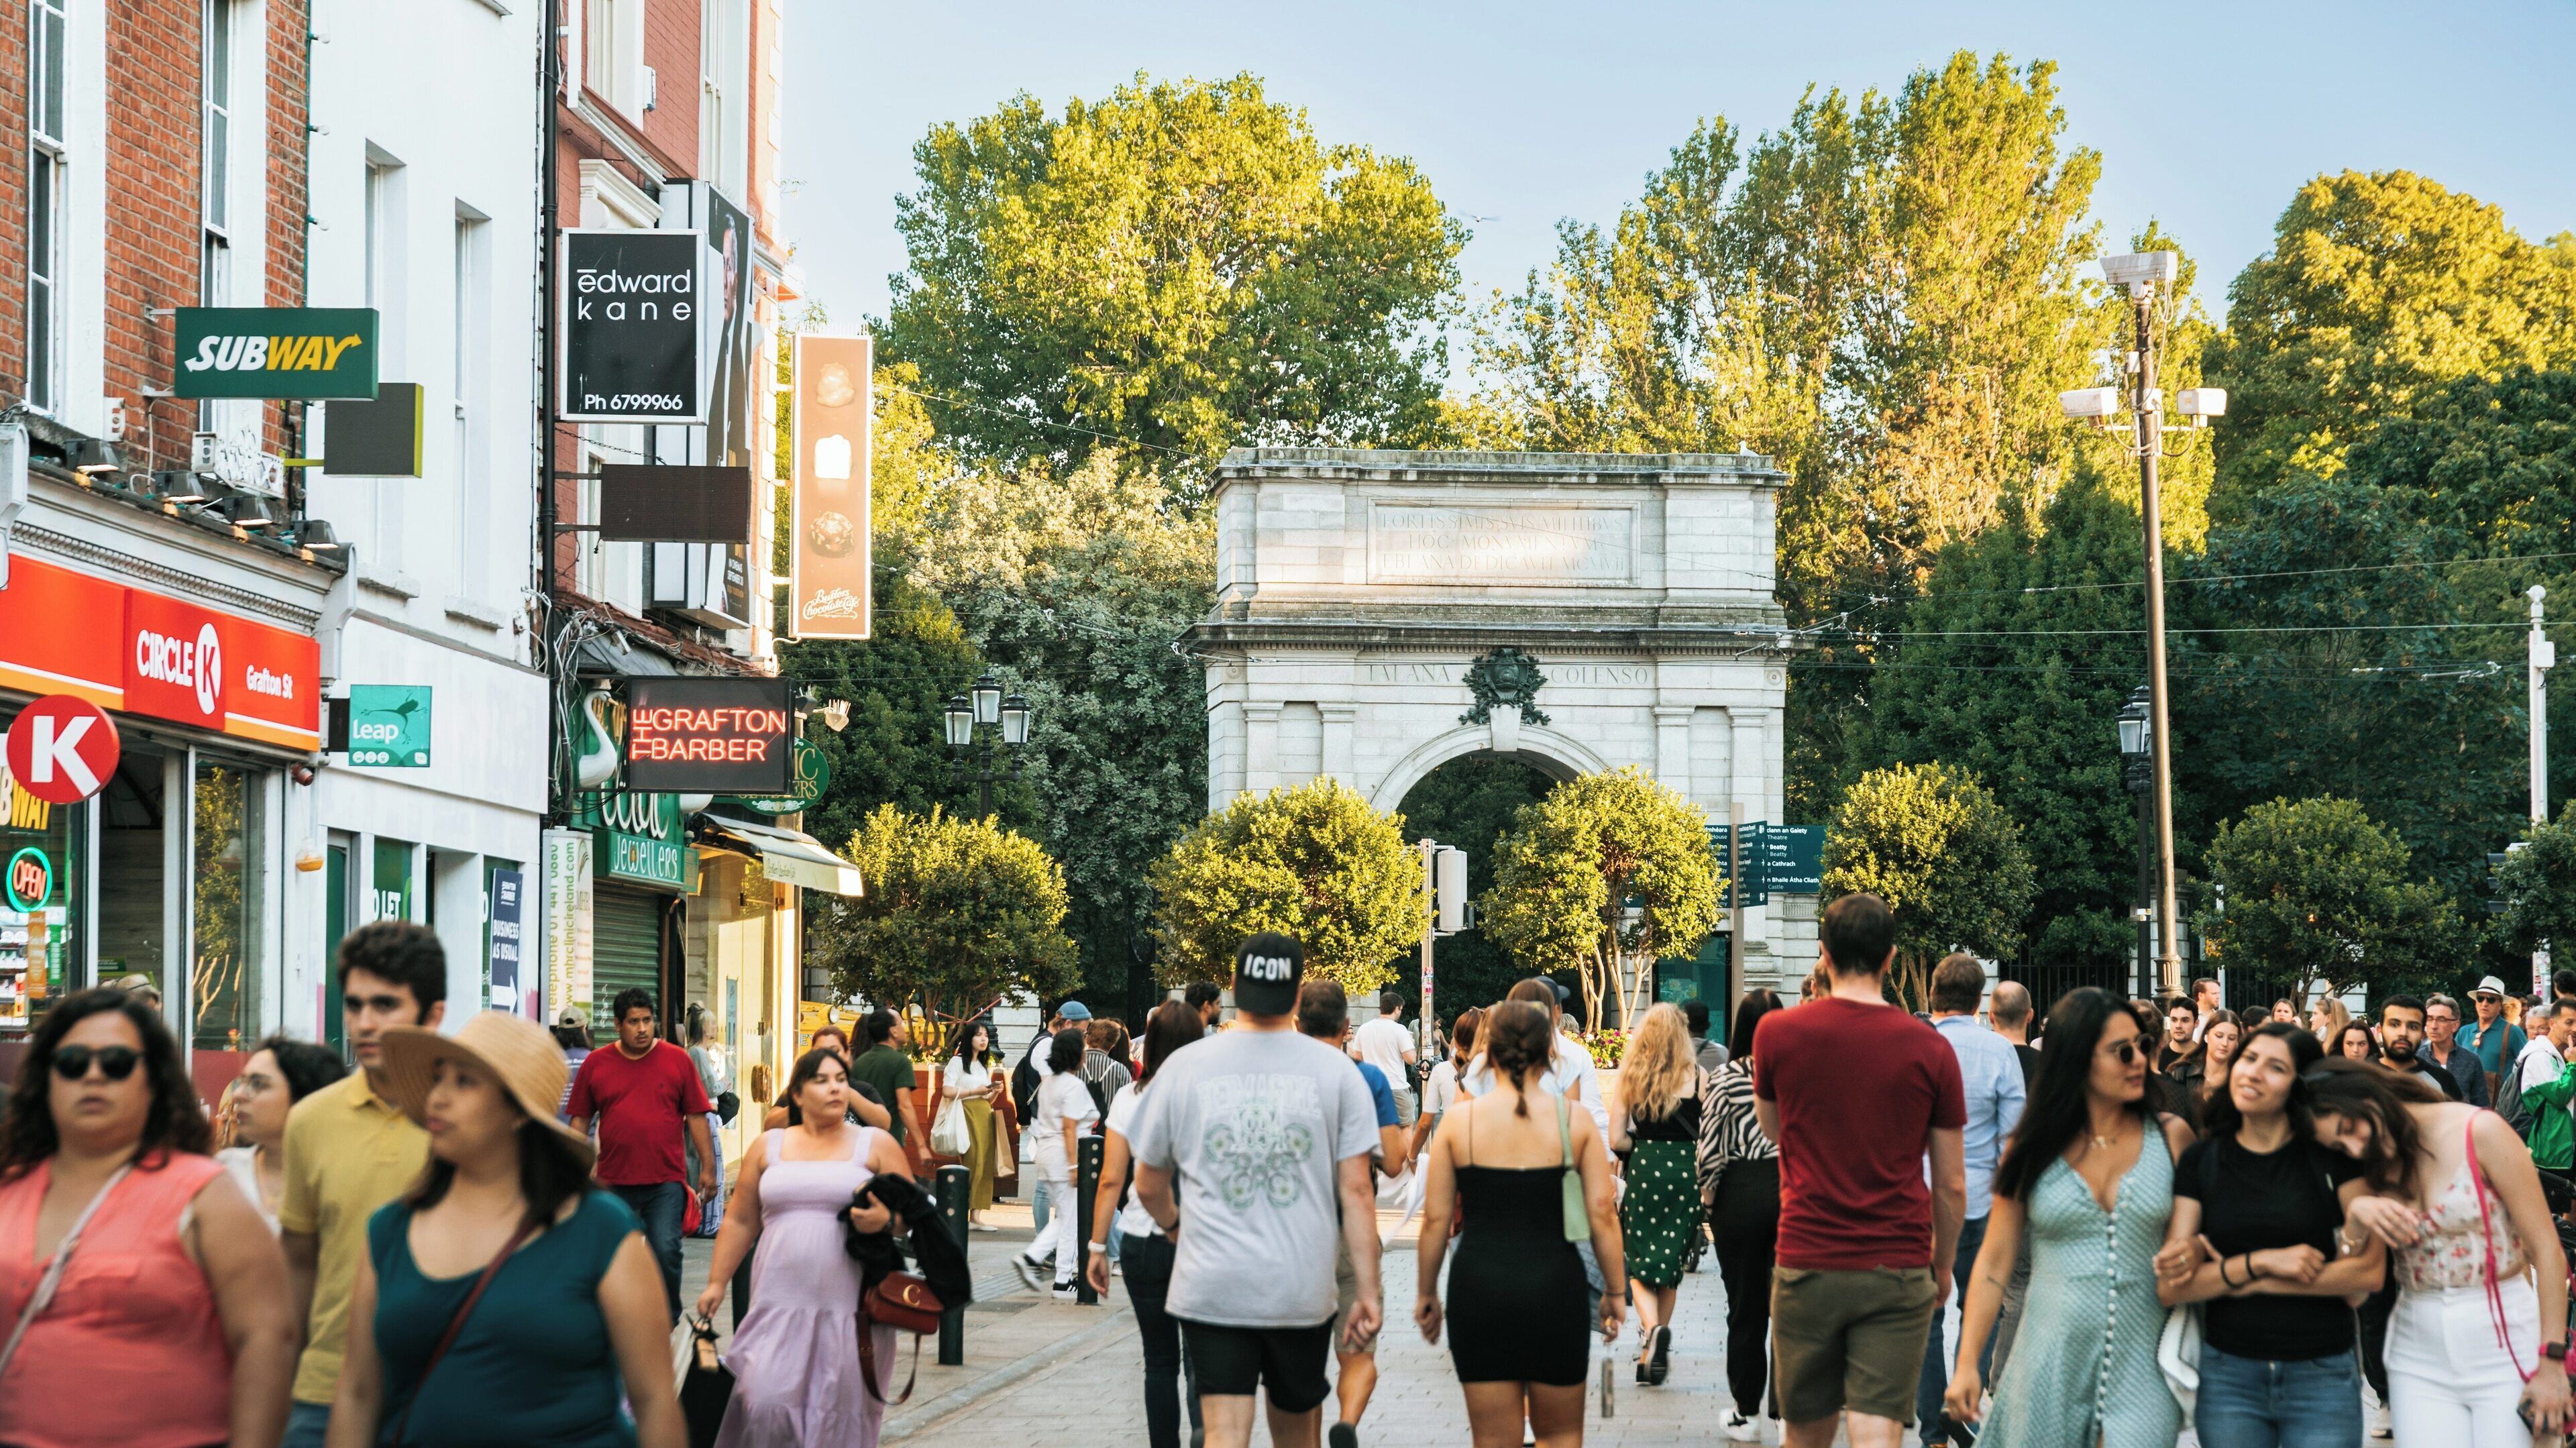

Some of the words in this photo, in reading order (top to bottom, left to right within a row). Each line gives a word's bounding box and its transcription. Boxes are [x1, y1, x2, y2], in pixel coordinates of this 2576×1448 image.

[578, 296, 692, 321] kane
[184, 334, 362, 372] SUBWAY
[584, 394, 606, 410] Ph
[610, 394, 683, 410] 6799966
[136, 629, 193, 687] CIRCLE
[246, 665, 281, 695] Grafton
[282, 673, 293, 700] St
[1551, 666, 1648, 684] COLENSO
[353, 719, 399, 744] leap
[632, 708, 653, 760] THE
[652, 708, 786, 734] GRAFTON
[30, 715, 101, 798] K
[651, 738, 765, 761] BARBER
[12, 859, 47, 900] OPEN
[381, 890, 401, 923] LET
[493, 919, 520, 940] BUSINESS
[564, 842, 575, 1006] ww.mhrclinicireland.com
[492, 942, 500, 960] AS
[500, 942, 519, 962] USUAL
[1244, 953, 1291, 981] ICON
